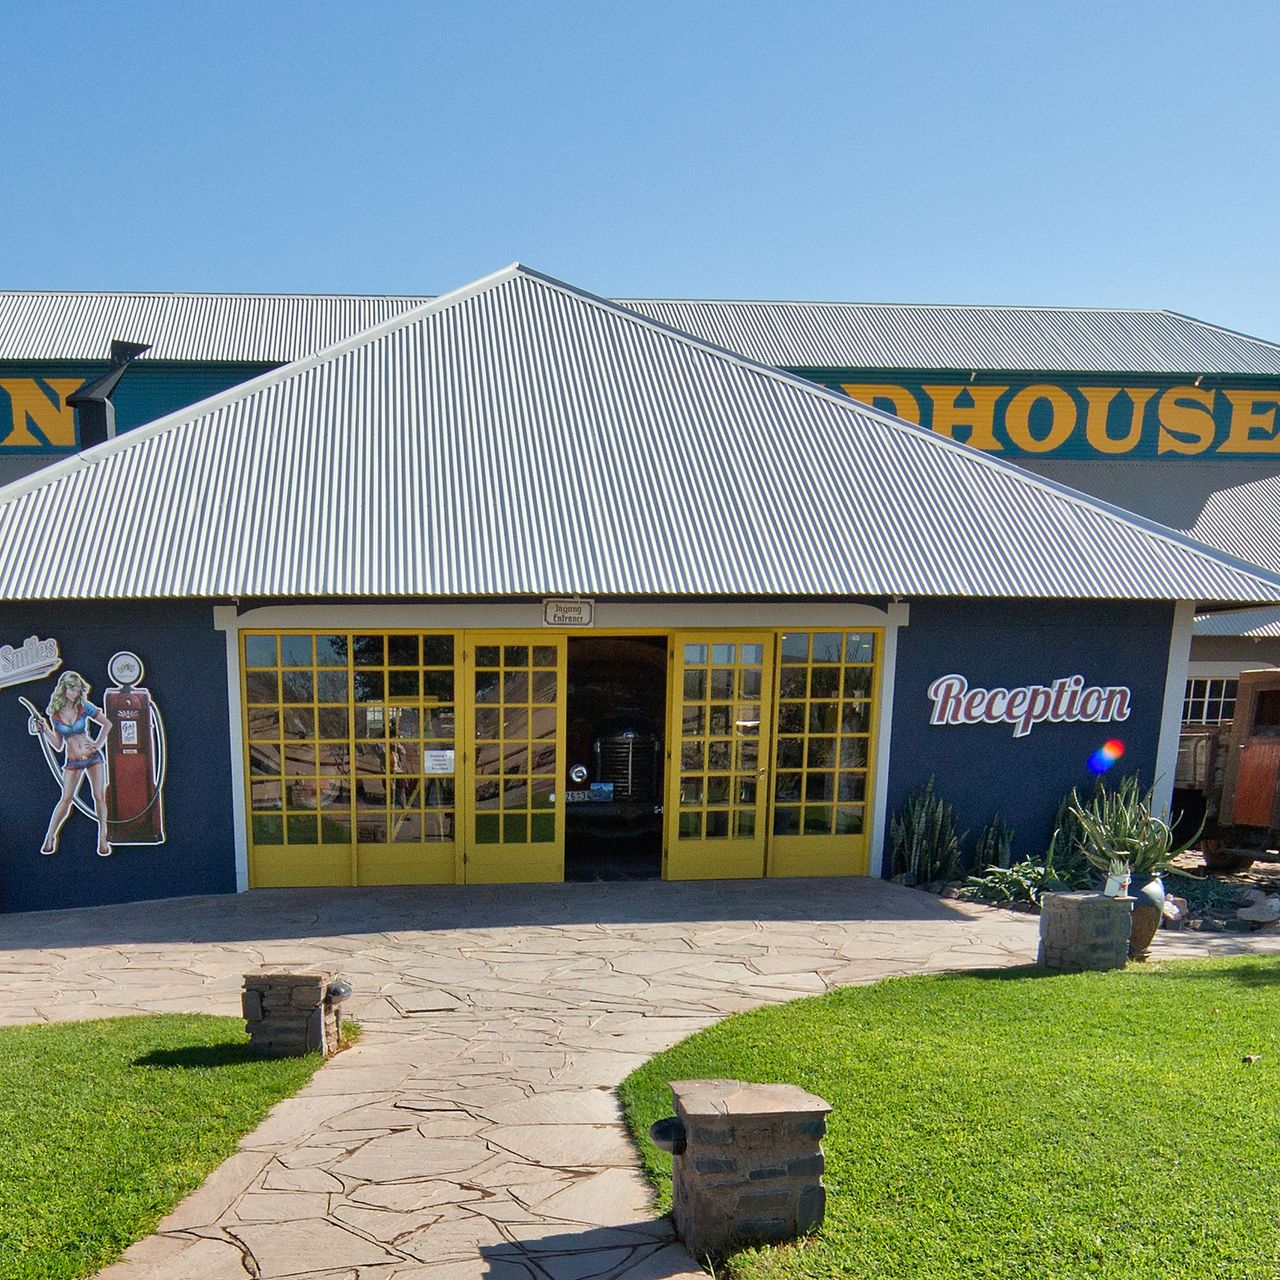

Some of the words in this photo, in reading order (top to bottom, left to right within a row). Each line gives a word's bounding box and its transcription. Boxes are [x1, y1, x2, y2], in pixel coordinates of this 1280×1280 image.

[553, 613, 584, 623] Entrance
[0, 636, 57, 673] Smiles
[928, 674, 1131, 738] Reception
